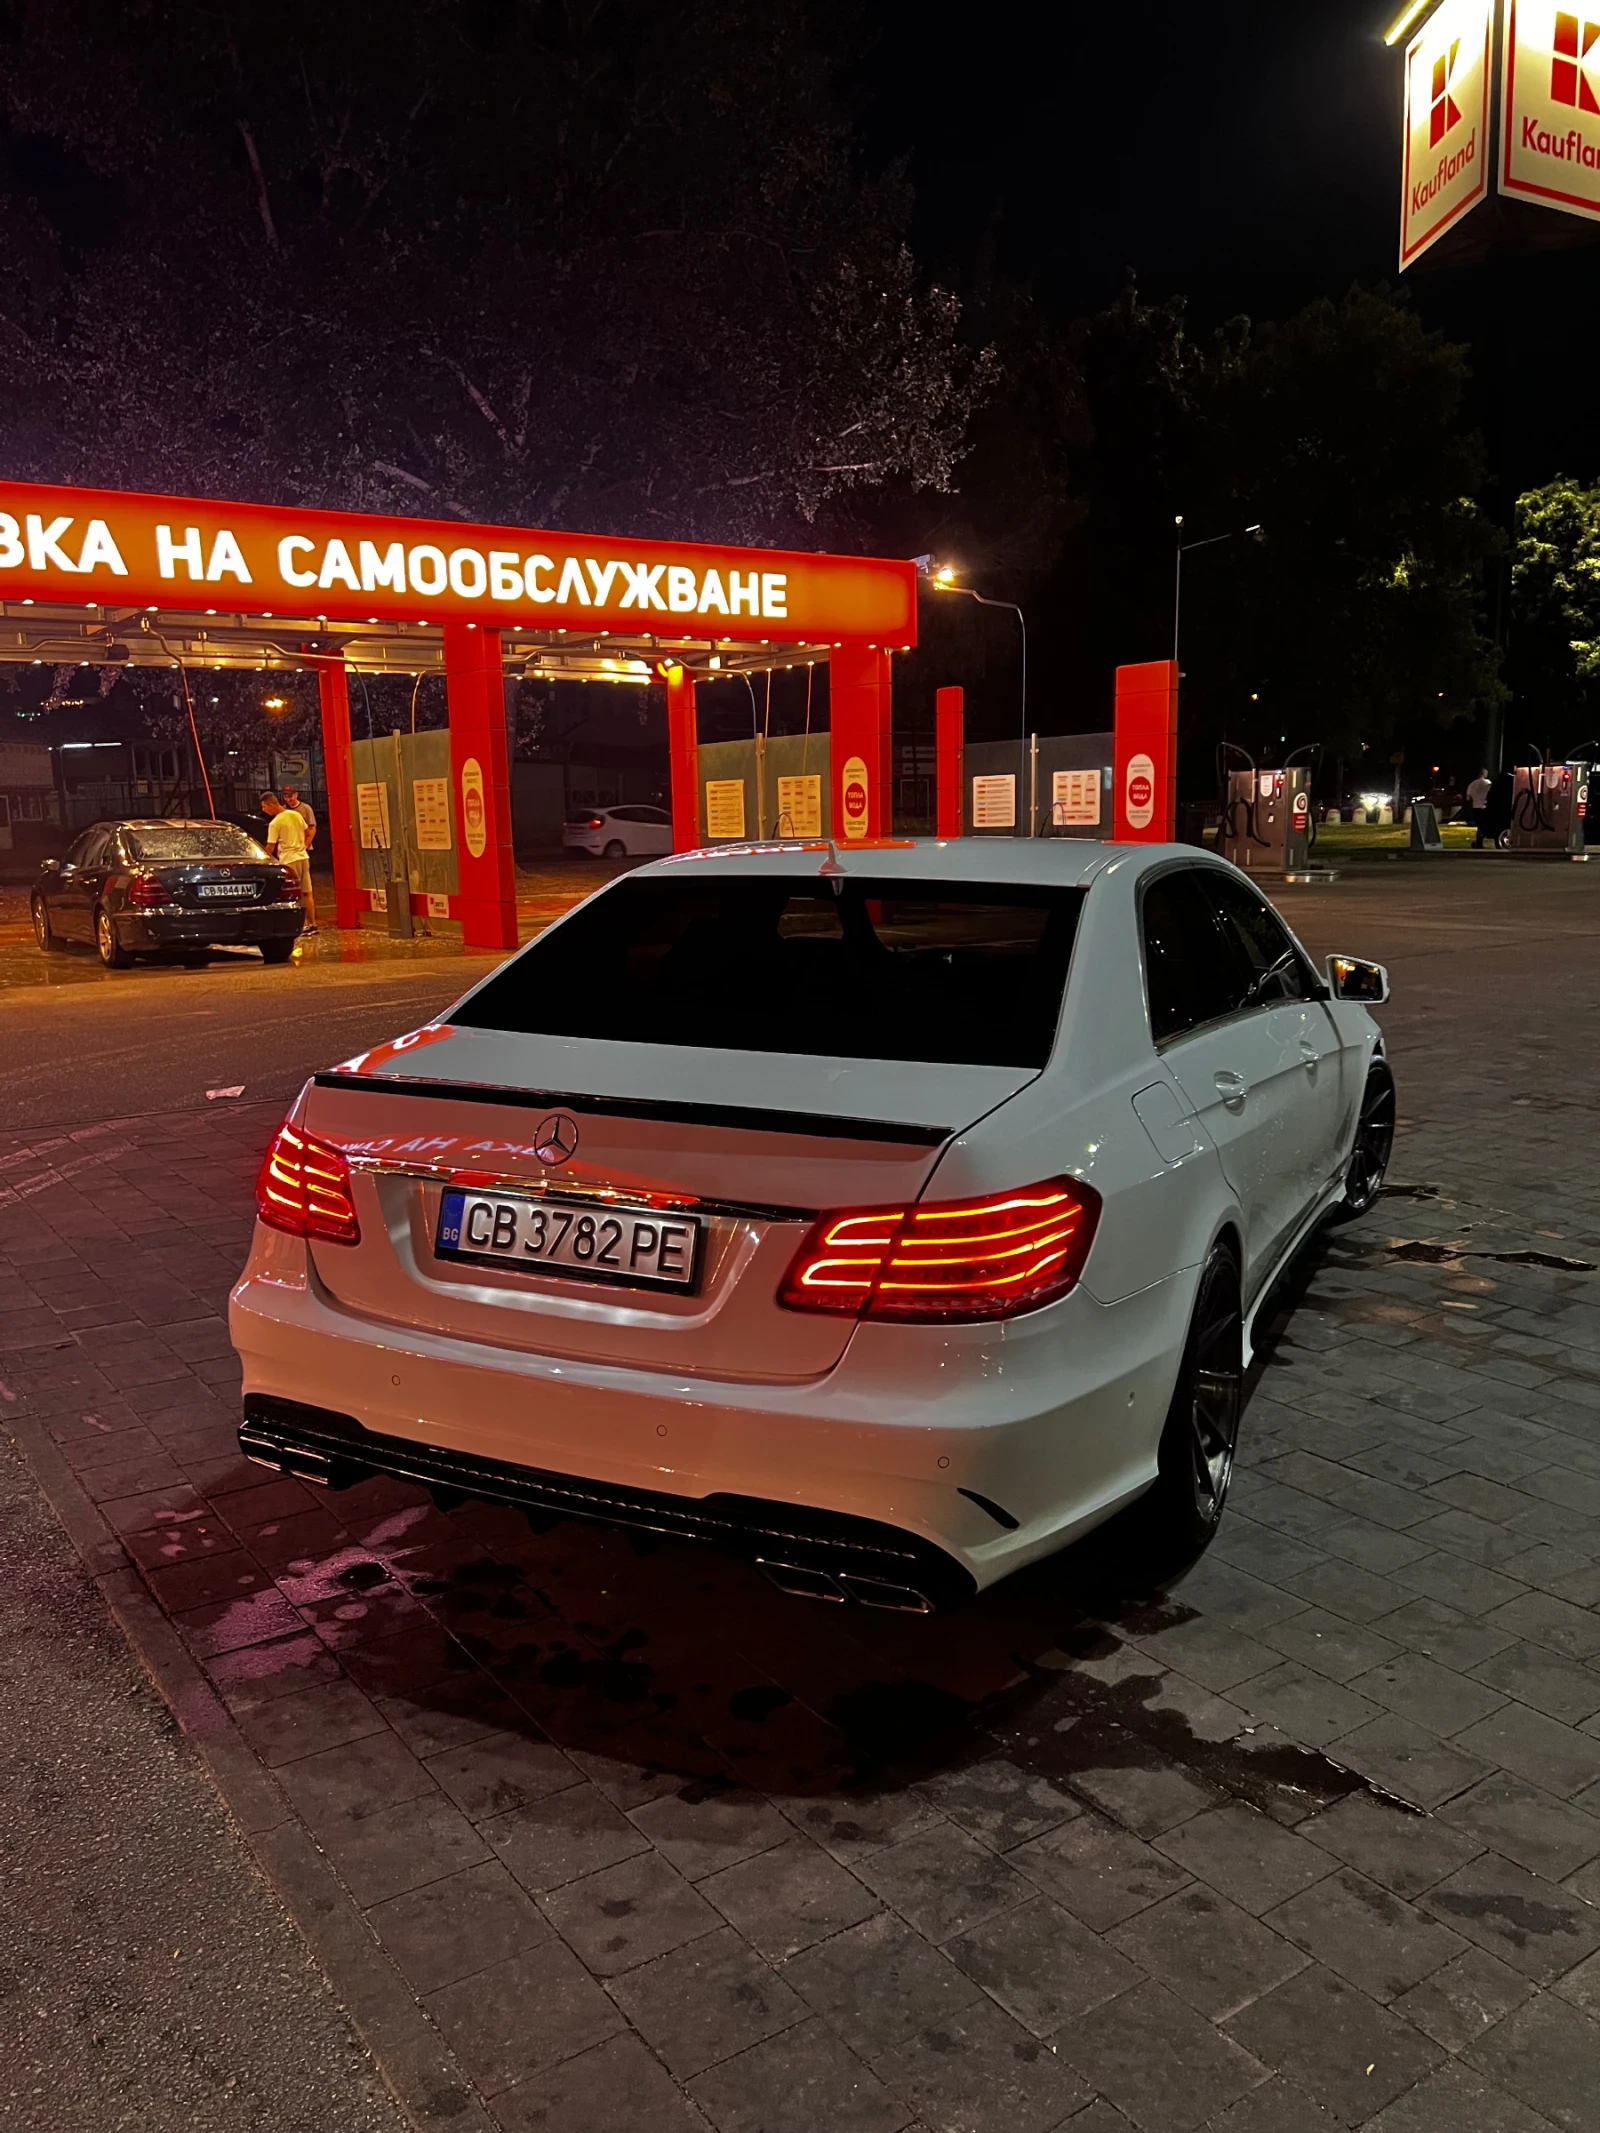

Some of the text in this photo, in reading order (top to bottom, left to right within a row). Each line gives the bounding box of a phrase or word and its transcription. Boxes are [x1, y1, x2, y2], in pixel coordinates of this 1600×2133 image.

[1411, 126, 1476, 216] Kaufland
[155, 524, 253, 583] НА
[277, 534, 788, 619] САМООБСЛУЖВАНЕ
[442, 1226, 459, 1241] BG
[524, 1210, 623, 1265] 3782
[630, 1223, 687, 1273] PE
